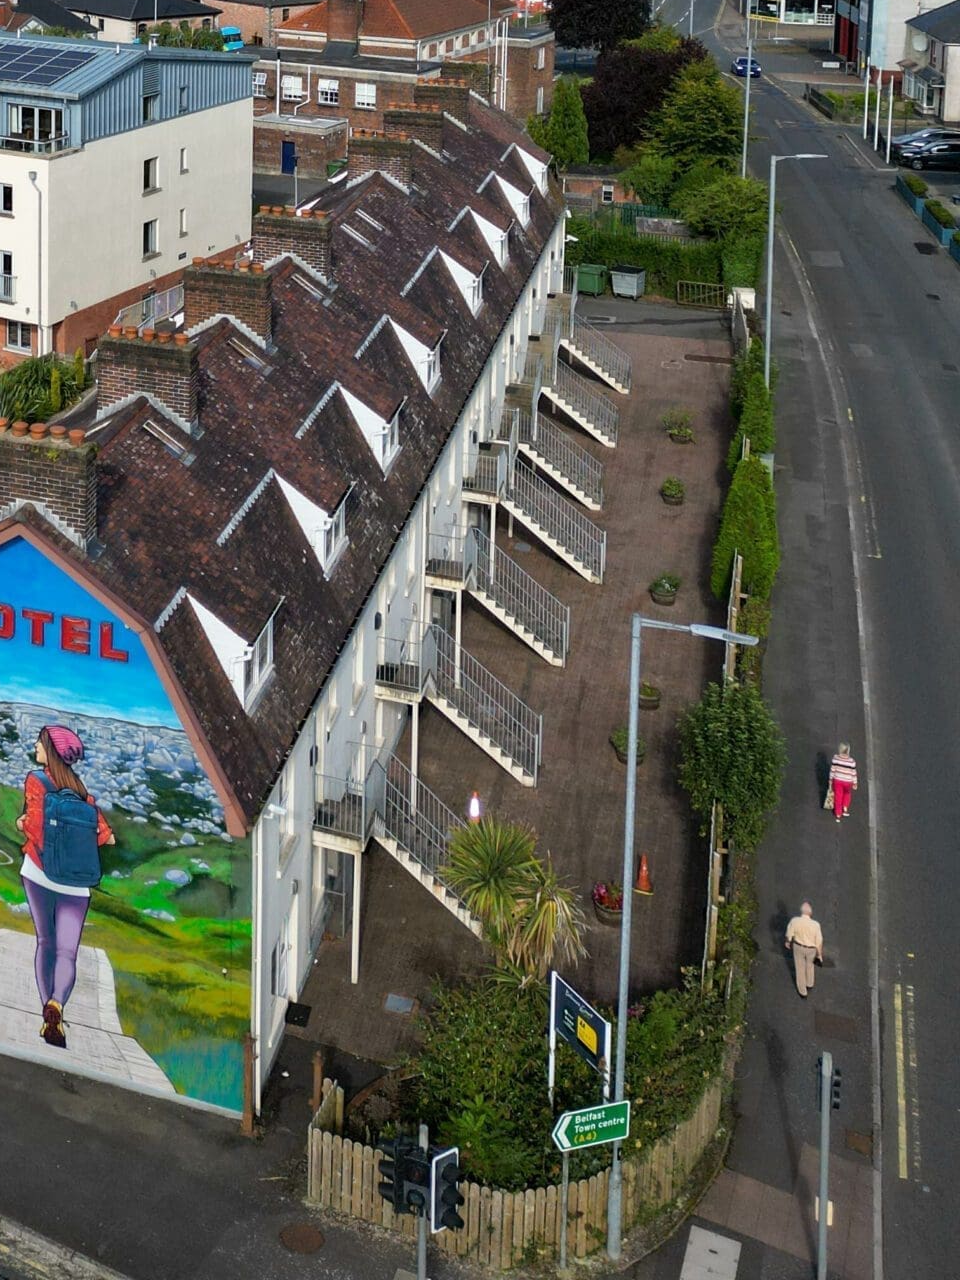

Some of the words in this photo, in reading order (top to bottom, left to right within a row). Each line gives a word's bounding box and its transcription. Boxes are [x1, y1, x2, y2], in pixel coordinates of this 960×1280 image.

[575, 1110, 605, 1124] Belfast
[574, 1123, 596, 1133] Town
[598, 1117, 625, 1128] centre
[574, 1130, 597, 1144] (A4)
